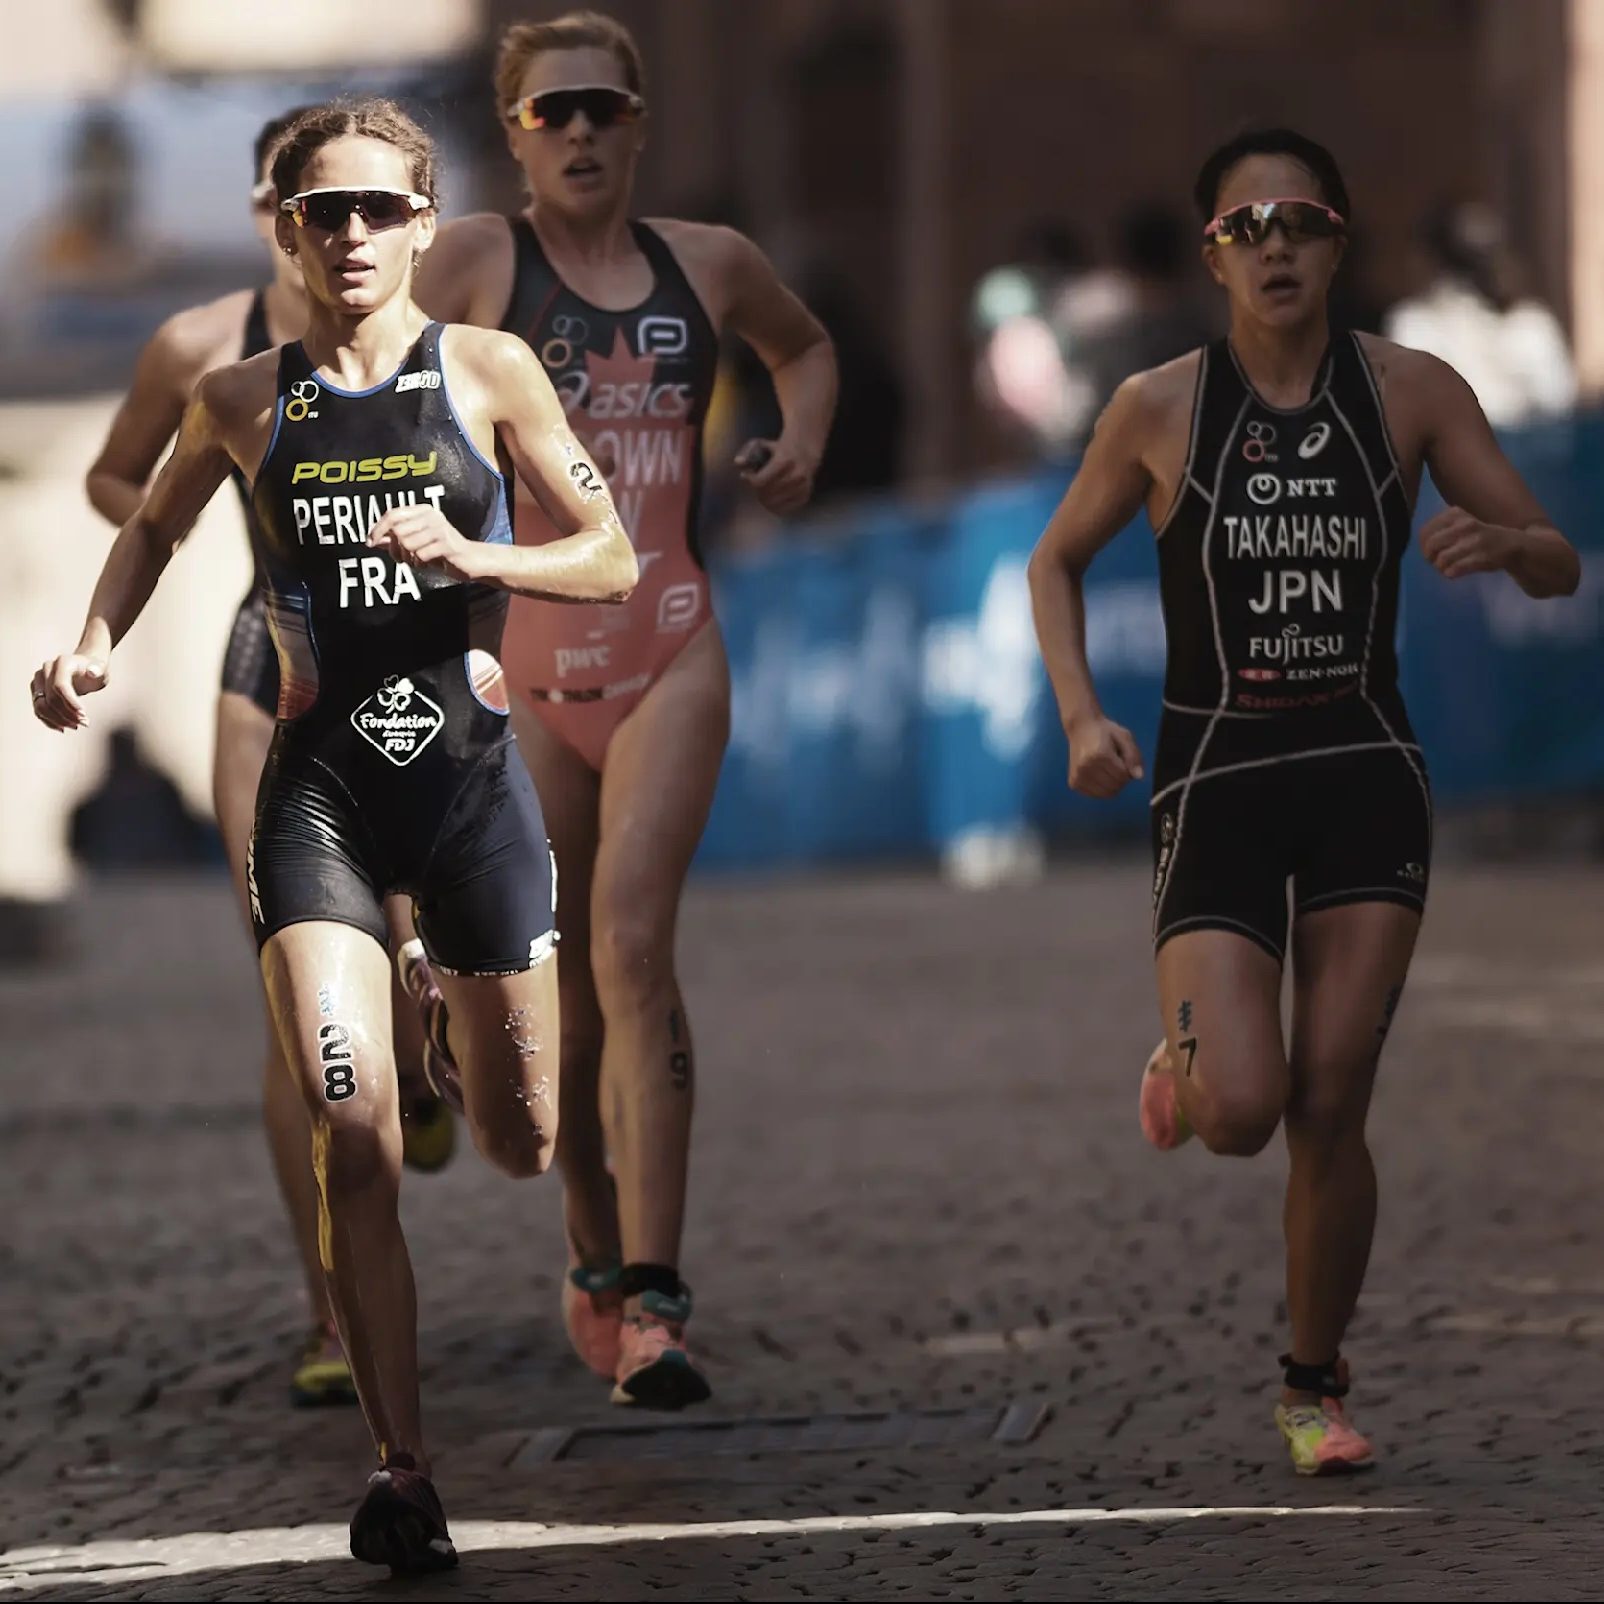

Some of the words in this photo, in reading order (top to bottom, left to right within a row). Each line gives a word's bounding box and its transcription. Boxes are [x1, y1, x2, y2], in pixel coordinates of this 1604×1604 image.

[588, 383, 692, 420] asics
[291, 451, 438, 485] POISSY
[1286, 477, 1337, 497] NTT
[1223, 514, 1367, 560] TAKAHASHI
[338, 556, 423, 609] FRA
[1248, 569, 1344, 615] JPN
[1249, 623, 1344, 665] FUJITSU
[360, 712, 437, 729] Fondation
[384, 738, 416, 751] FDJ
[318, 1023, 357, 1102] 28
